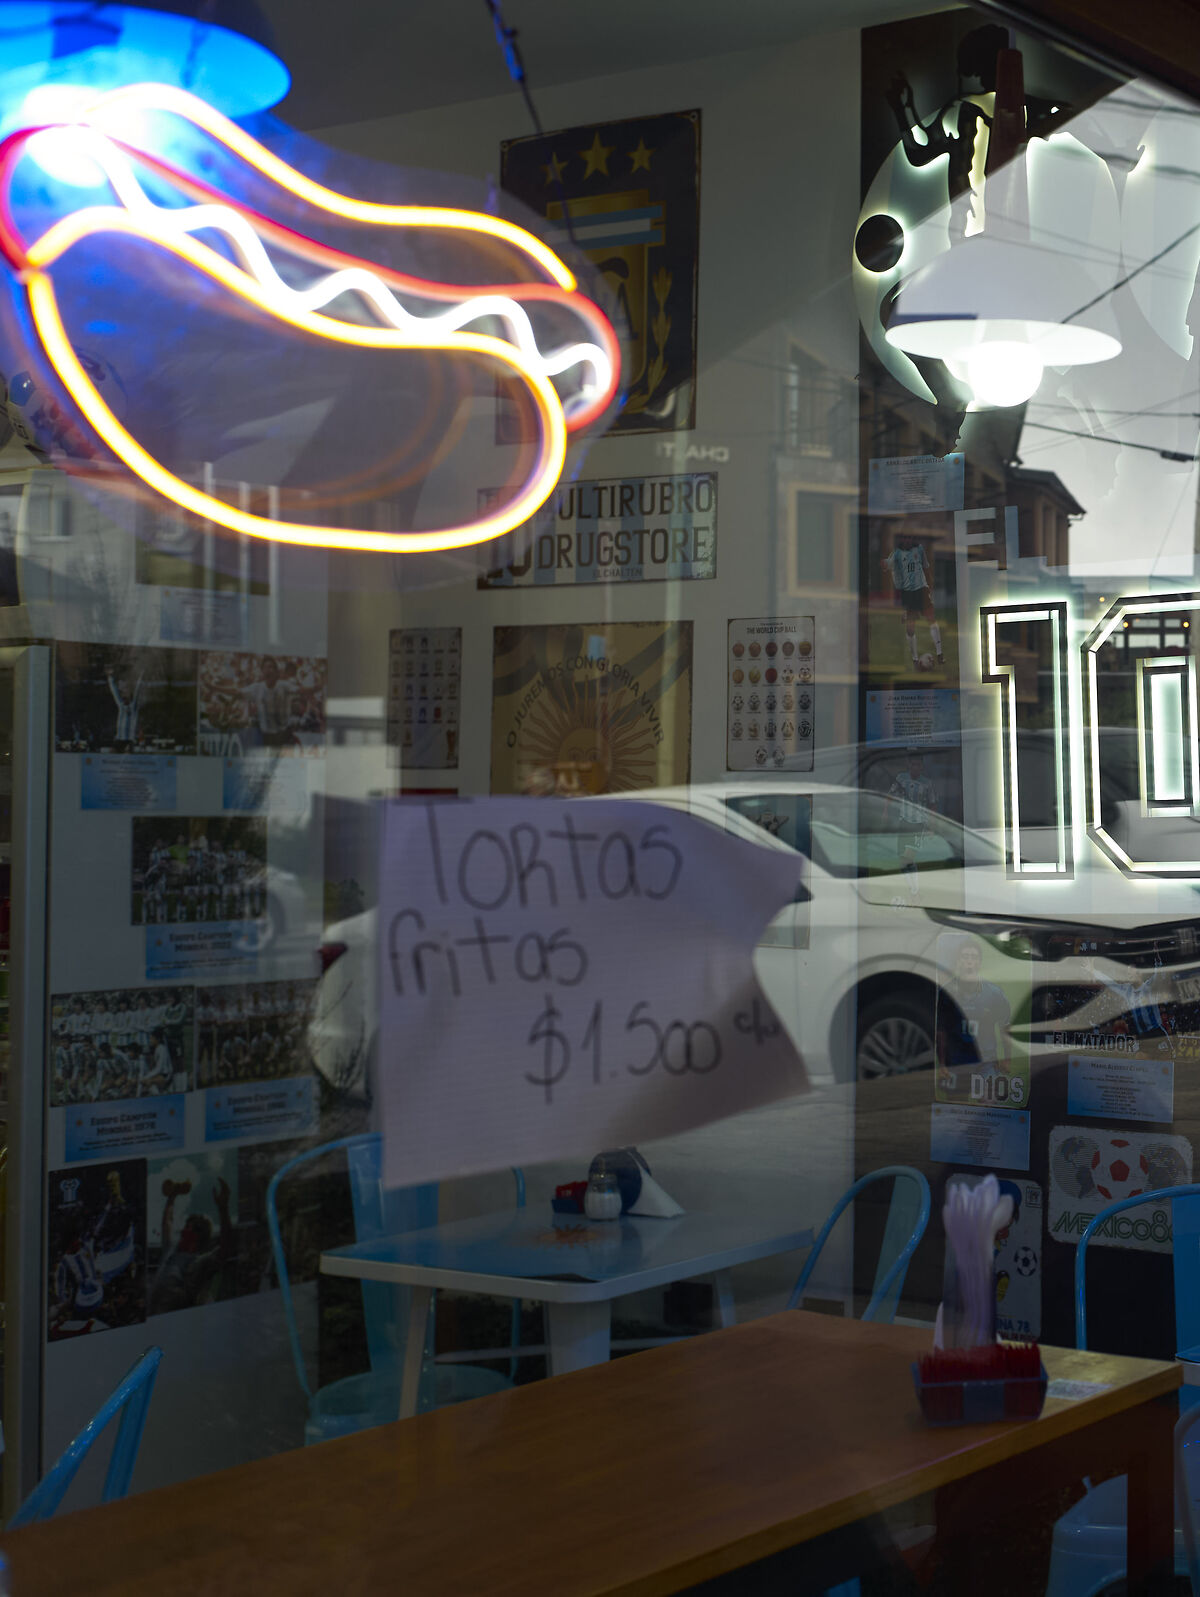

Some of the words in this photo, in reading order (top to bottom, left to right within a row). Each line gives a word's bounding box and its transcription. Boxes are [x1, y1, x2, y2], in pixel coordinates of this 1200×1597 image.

[540, 479, 714, 522] ULTIRUBRO
[537, 526, 711, 570] DRUGSTORE
[954, 505, 1047, 571] EL
[566, 655, 593, 673] CON
[523, 992, 723, 1105] $1.500
[1074, 1032, 1136, 1053] MATADOR
[1052, 1209, 1173, 1244] MEXICO8
